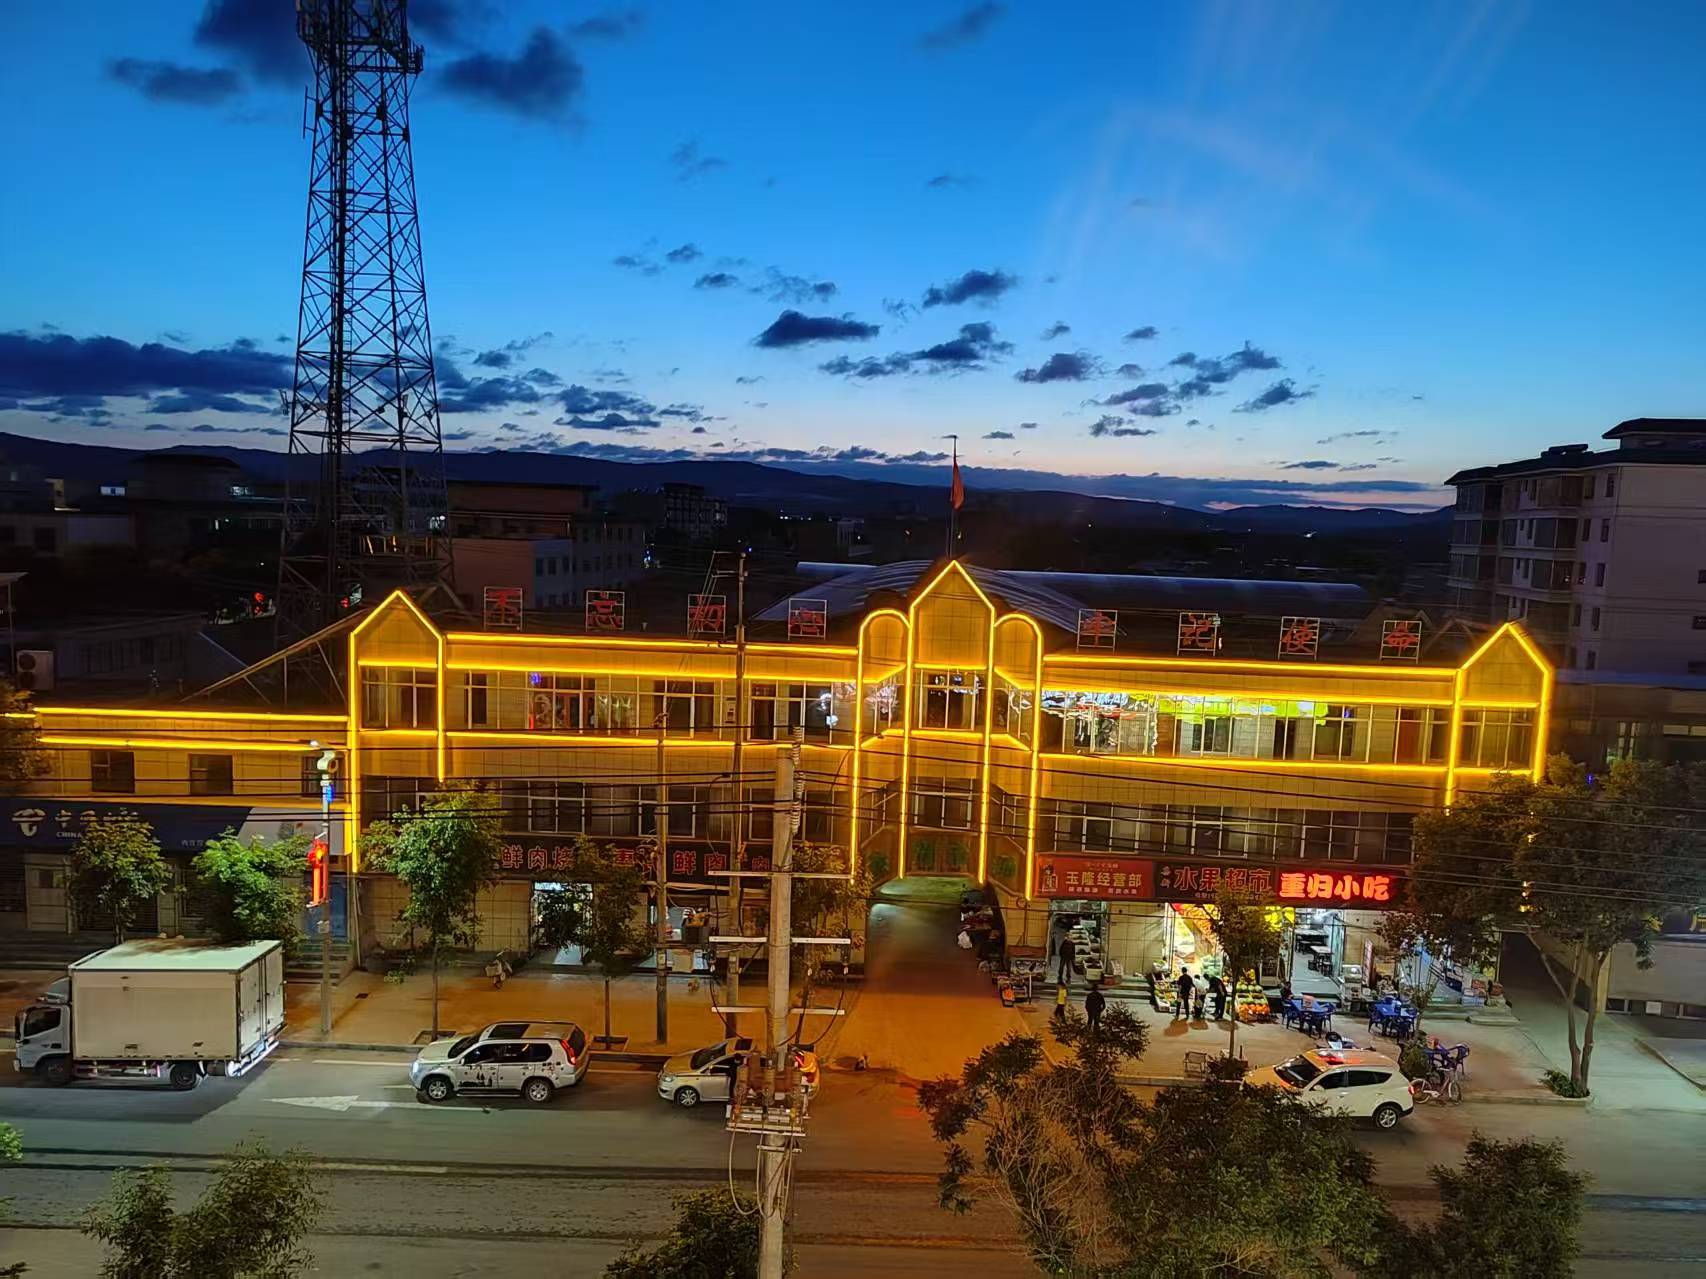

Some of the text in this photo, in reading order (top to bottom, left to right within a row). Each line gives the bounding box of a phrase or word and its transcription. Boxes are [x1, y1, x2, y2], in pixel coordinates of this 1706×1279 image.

[1173, 866, 1271, 893] 水果超市
[1280, 873, 1389, 900] 重归小吃
